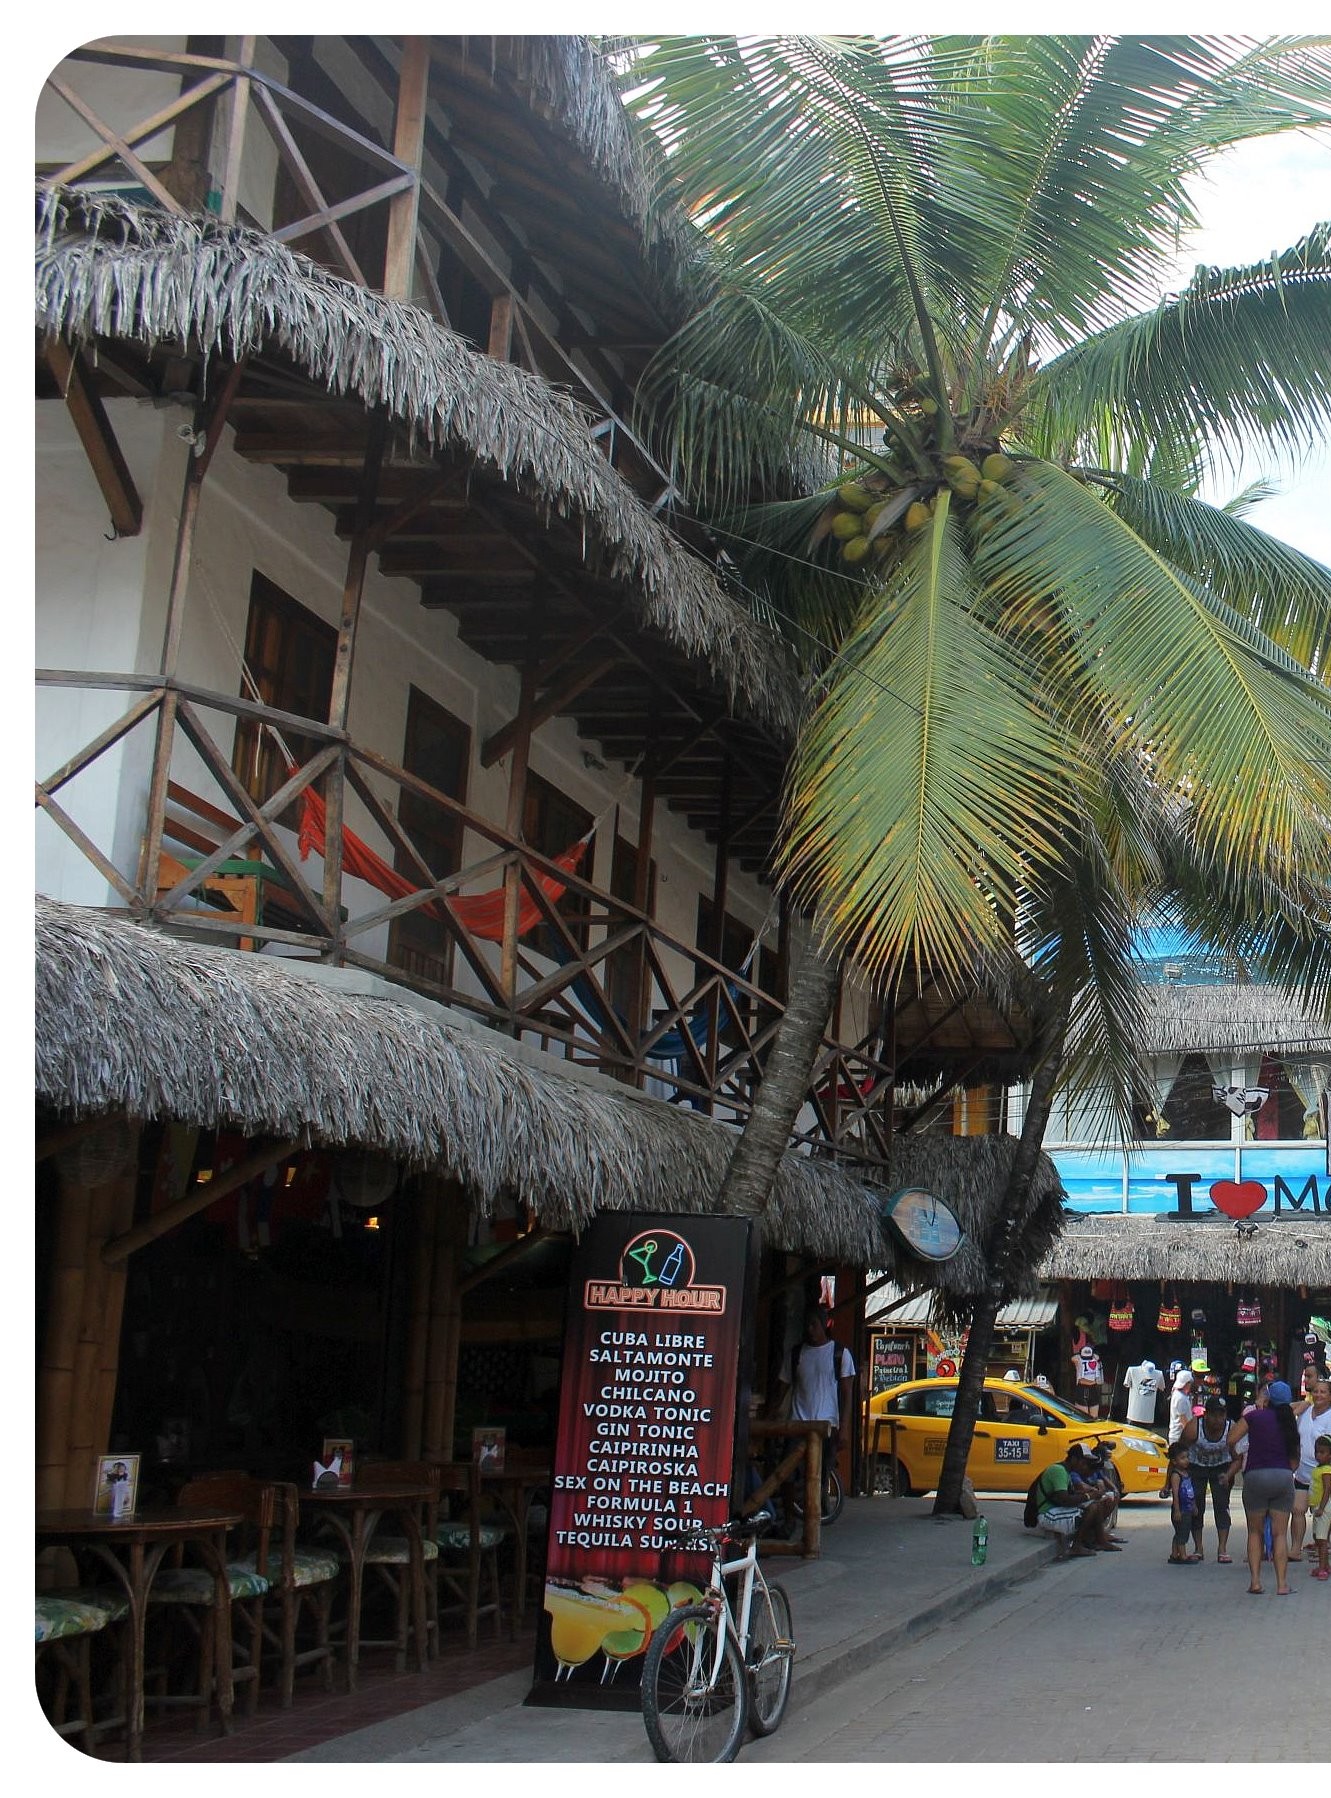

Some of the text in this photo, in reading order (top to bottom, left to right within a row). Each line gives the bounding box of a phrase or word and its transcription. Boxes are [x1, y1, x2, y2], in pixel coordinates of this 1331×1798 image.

[1166, 1174, 1202, 1218] I
[589, 1285, 721, 1310] HAPPY HOUR
[600, 1331, 705, 1349] CUBA LIBRE
[589, 1349, 713, 1368] SALTAMONTE
[615, 1368, 685, 1385] MOJITO
[601, 1386, 696, 1403] CHILCANO
[583, 1403, 712, 1422] VODKA TONIC
[596, 1422, 695, 1440] GIN TONIC
[589, 1440, 699, 1459] CAIPIRINHA
[998, 1446, 1021, 1458] 35-15
[586, 1458, 699, 1477] CAIPIROSKA
[554, 1476, 728, 1497] SEX ON THE BEACH
[587, 1495, 693, 1514] FORMULA 1
[574, 1513, 703, 1532] WHISKY SOUR
[556, 1530, 633, 1548] TEQUILA
